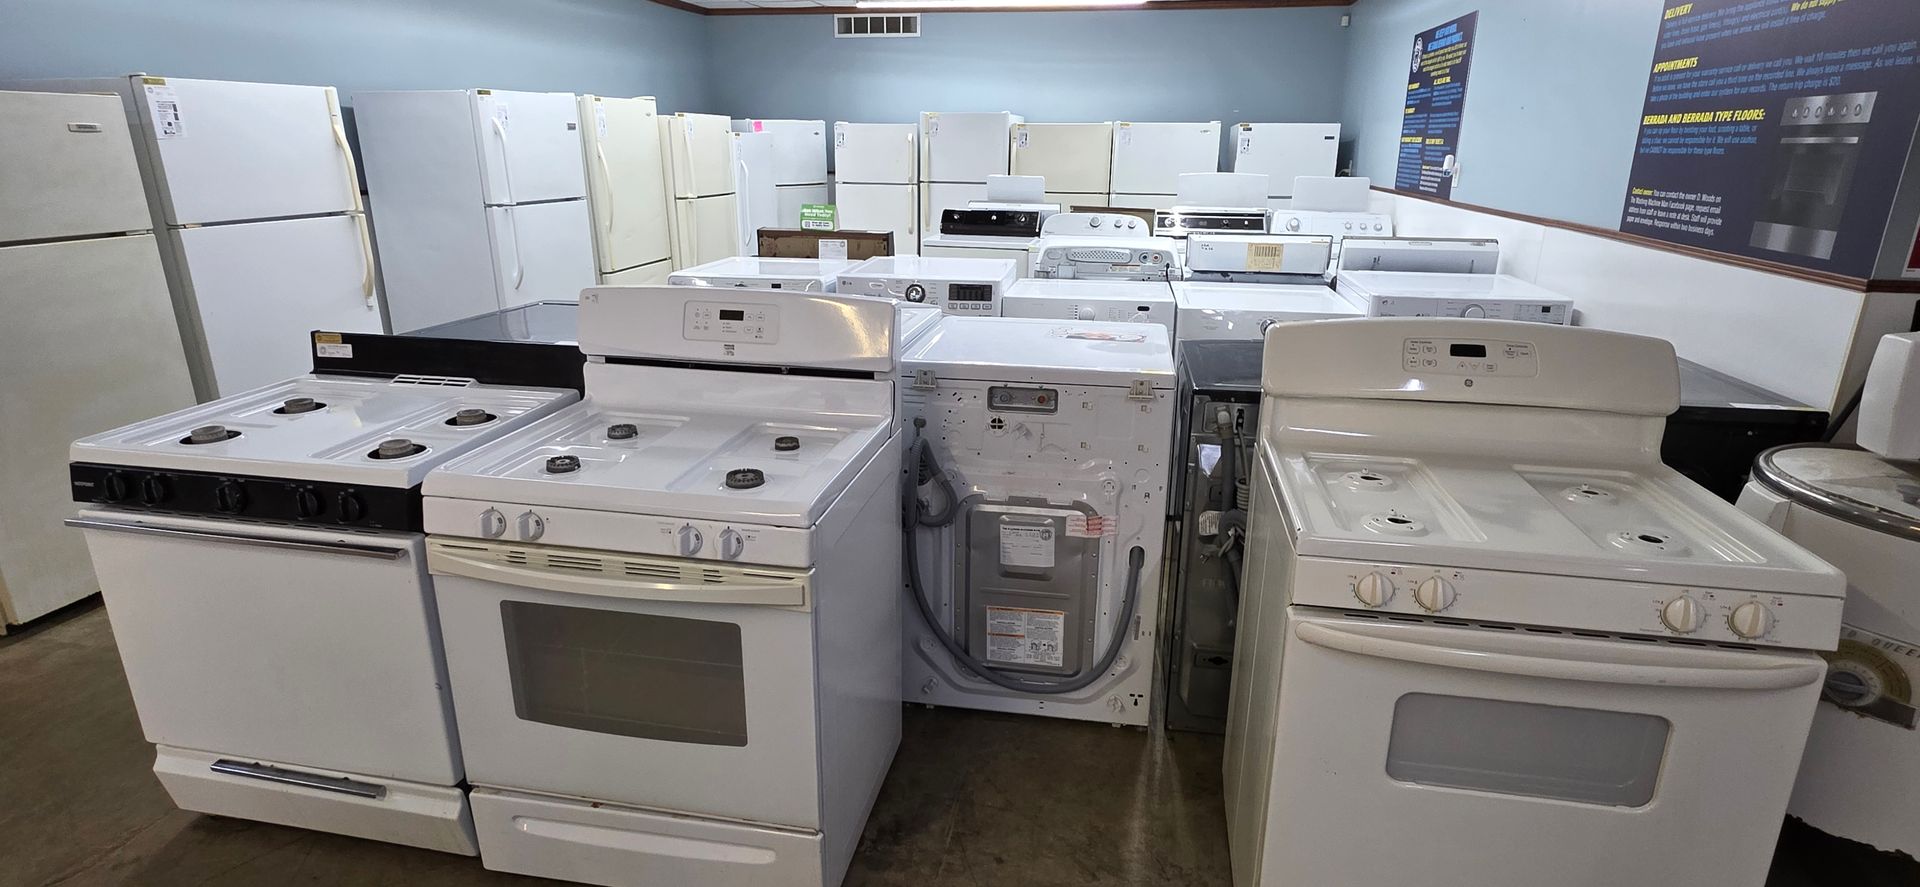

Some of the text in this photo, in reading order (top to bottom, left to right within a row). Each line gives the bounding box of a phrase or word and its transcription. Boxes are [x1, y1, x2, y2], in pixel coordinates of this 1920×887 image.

[1665, 3, 1692, 19] DELIVERY
[1791, 2, 1799, 11] We
[1800, 1, 1807, 9] do
[1772, 59, 1782, 67] call
[1794, 56, 1803, 64] We
[1803, 54, 1815, 63] wait
[1823, 50, 1847, 61] minutes
[1847, 49, 1860, 58] then
[1861, 47, 1871, 56] we
[1872, 45, 1884, 54] call
[1884, 43, 1897, 54] you
[1653, 57, 1698, 73] APPOINTMENTS
[1873, 58, 1882, 67] As
[1883, 57, 1894, 66] we
[1643, 108, 1765, 124] BERRADA AND BERRADA TYPE FLOORS:
[1701, 194, 1714, 202] Woods
[1709, 206, 1720, 214] email
[1706, 217, 1722, 226] provide
[1871, 638, 1920, 658] QUEE
